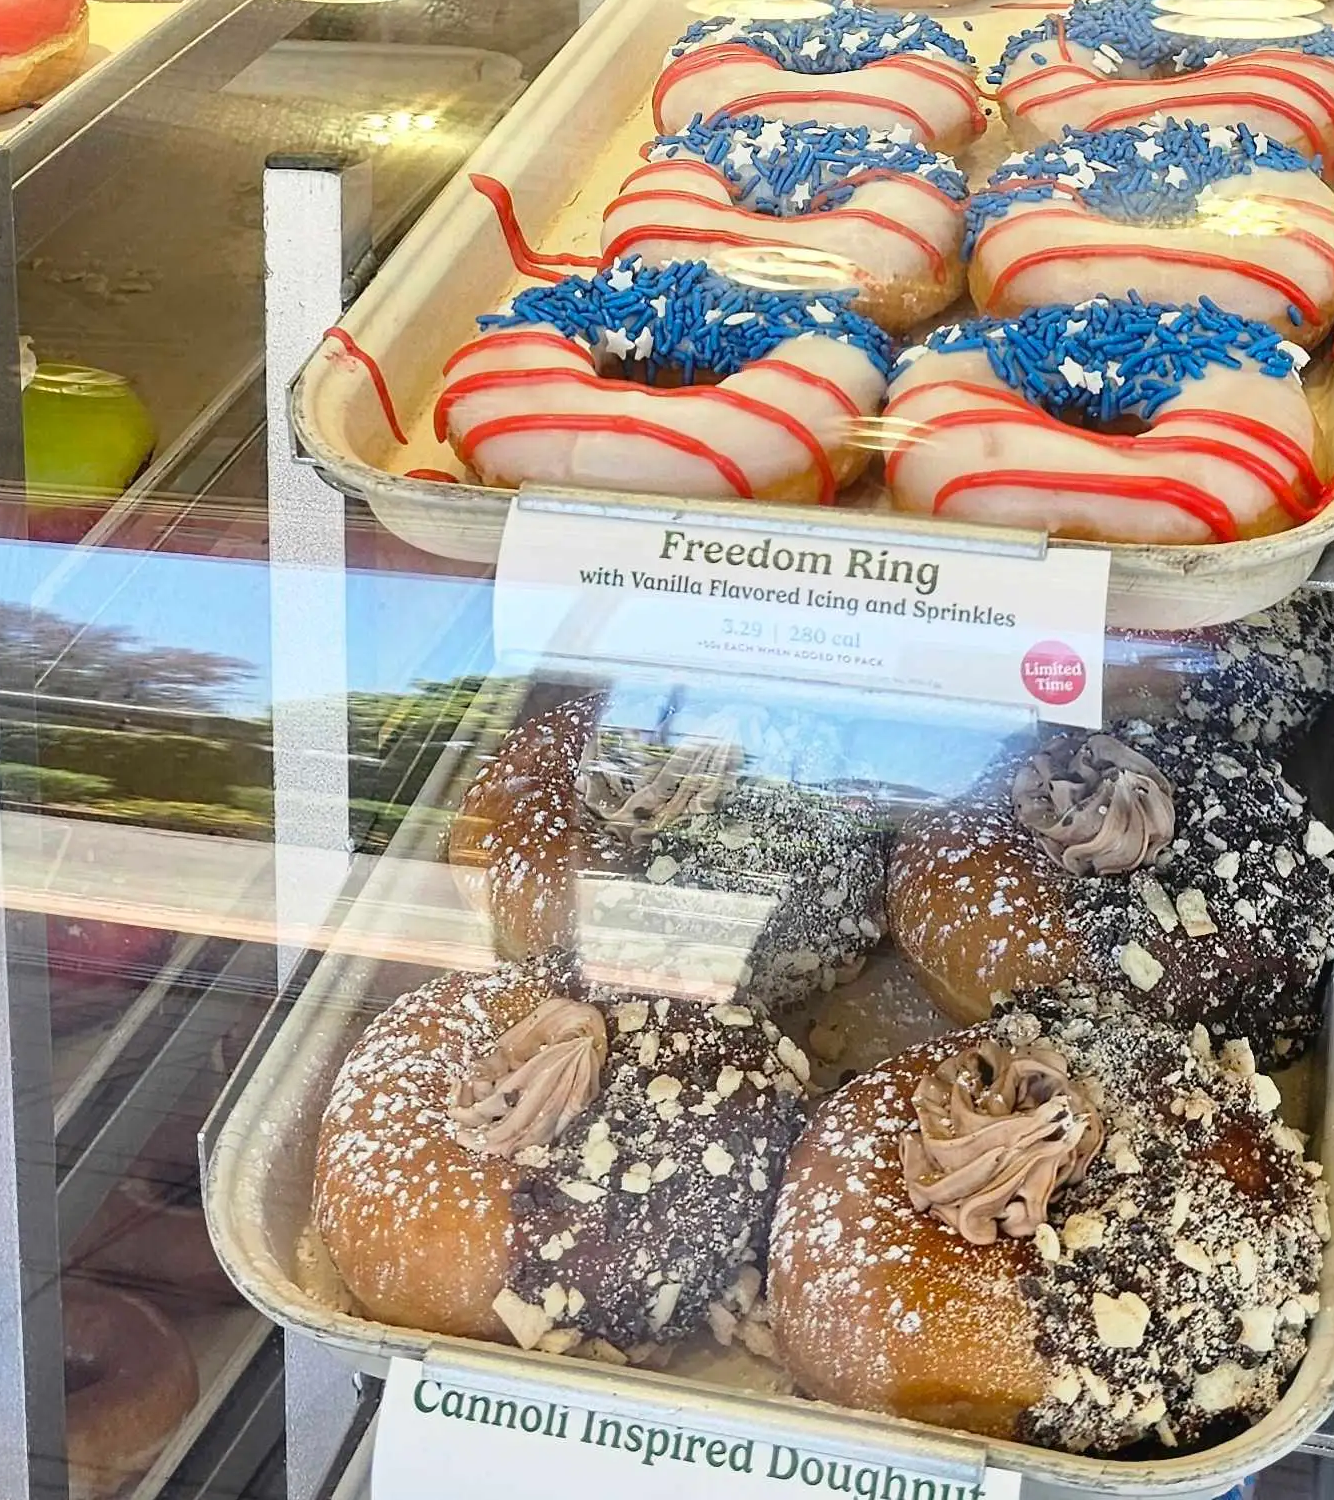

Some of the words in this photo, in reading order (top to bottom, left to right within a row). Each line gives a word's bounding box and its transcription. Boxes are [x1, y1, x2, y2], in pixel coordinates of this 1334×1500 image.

[659, 530, 832, 575] Freedom
[845, 548, 939, 595] Ring
[580, 567, 624, 587] with
[631, 570, 702, 595] Vanilla
[710, 580, 800, 606] Flavored
[807, 589, 859, 615] Icing
[866, 597, 906, 616] and
[913, 600, 1016, 628] Sprinkles
[722, 618, 763, 637] 3.29
[832, 631, 861, 648] cal
[724, 642, 754, 653] EACH
[758, 646, 790, 656] WHEN
[794, 650, 833, 661] ADDED
[837, 654, 851, 663] TO
[854, 656, 884, 667] PACK
[1025, 661, 1082, 676] Limited
[1035, 677, 1074, 691] Time
[413, 1379, 568, 1439] Cannoli
[582, 1408, 753, 1473] Inspired
